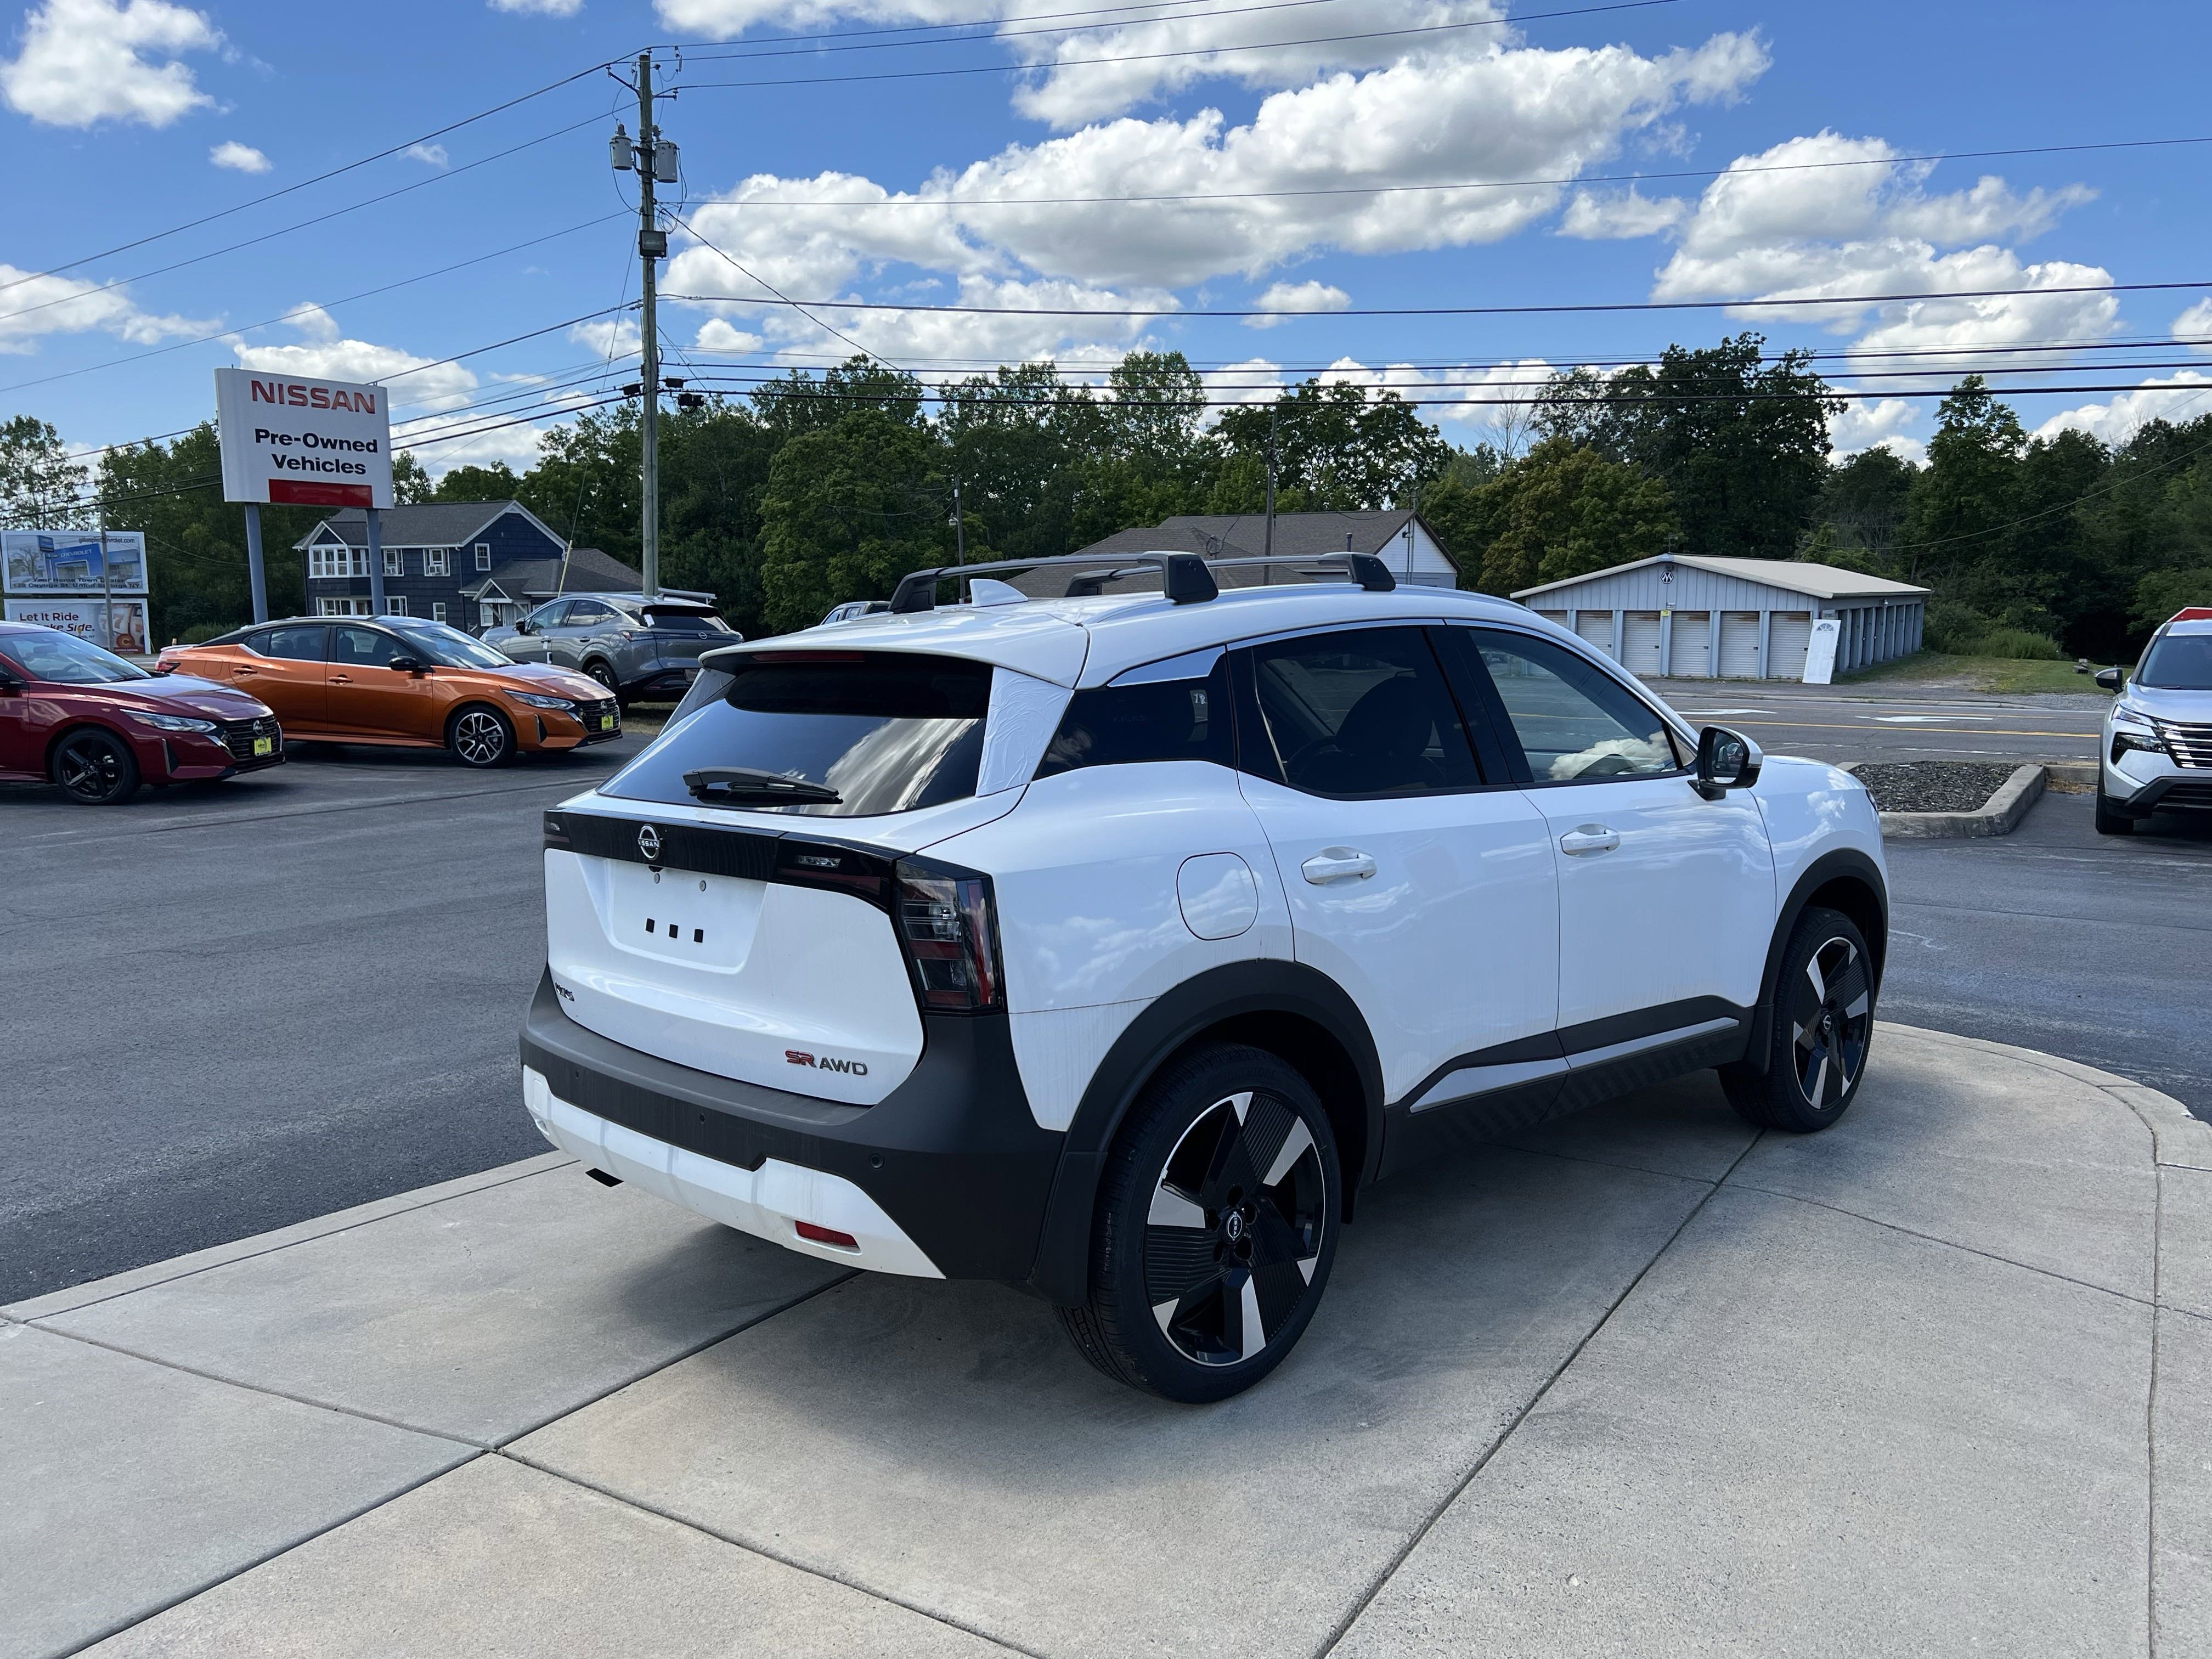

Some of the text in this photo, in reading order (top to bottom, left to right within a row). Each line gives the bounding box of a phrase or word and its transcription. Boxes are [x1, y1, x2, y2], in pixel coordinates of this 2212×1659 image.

[251, 380, 375, 414] NISSAN
[255, 428, 378, 453] Pre-Owned
[272, 454, 366, 475] Vehicles
[20, 612, 79, 621] Let It Ride
[785, 1049, 868, 1076] SR AWD
